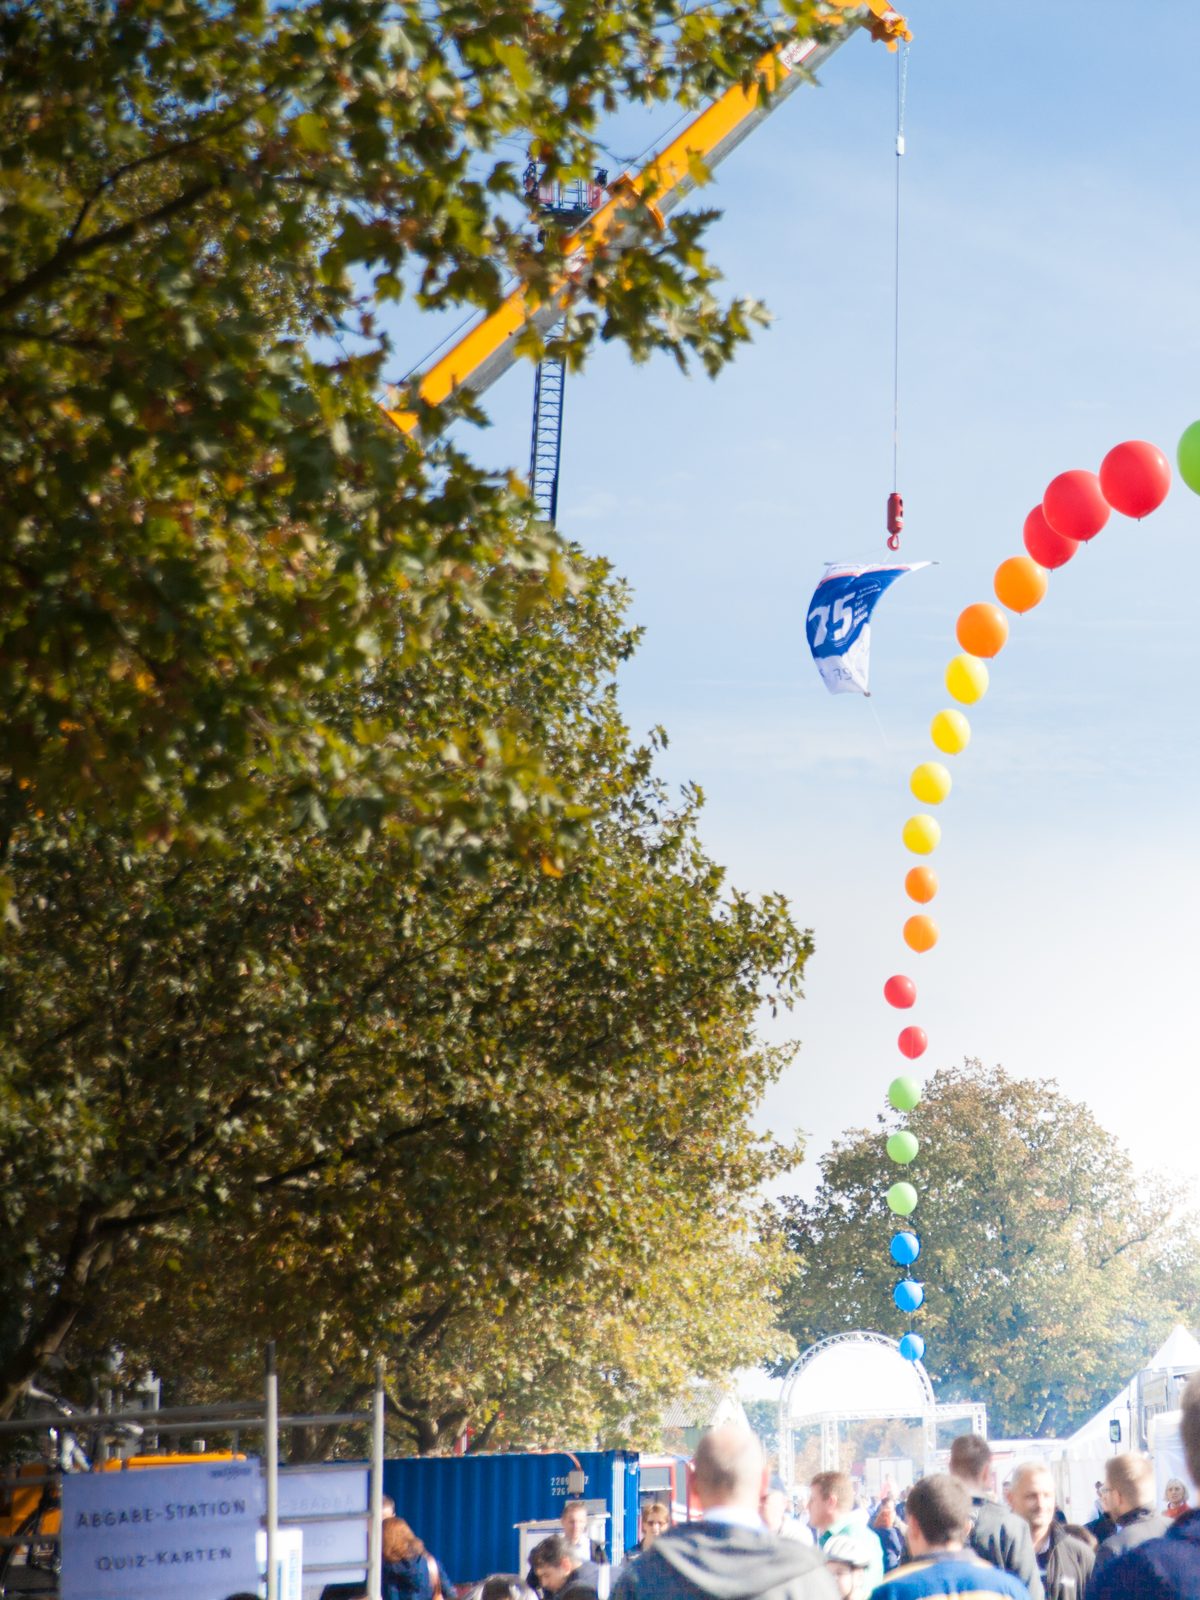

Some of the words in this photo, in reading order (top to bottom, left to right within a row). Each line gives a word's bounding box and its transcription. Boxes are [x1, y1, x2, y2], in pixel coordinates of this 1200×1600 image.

[808, 592, 856, 648] 75
[77, 1500, 246, 1528] ABGABE-STATION
[97, 1547, 232, 1571] QUIZ-KARTEN
